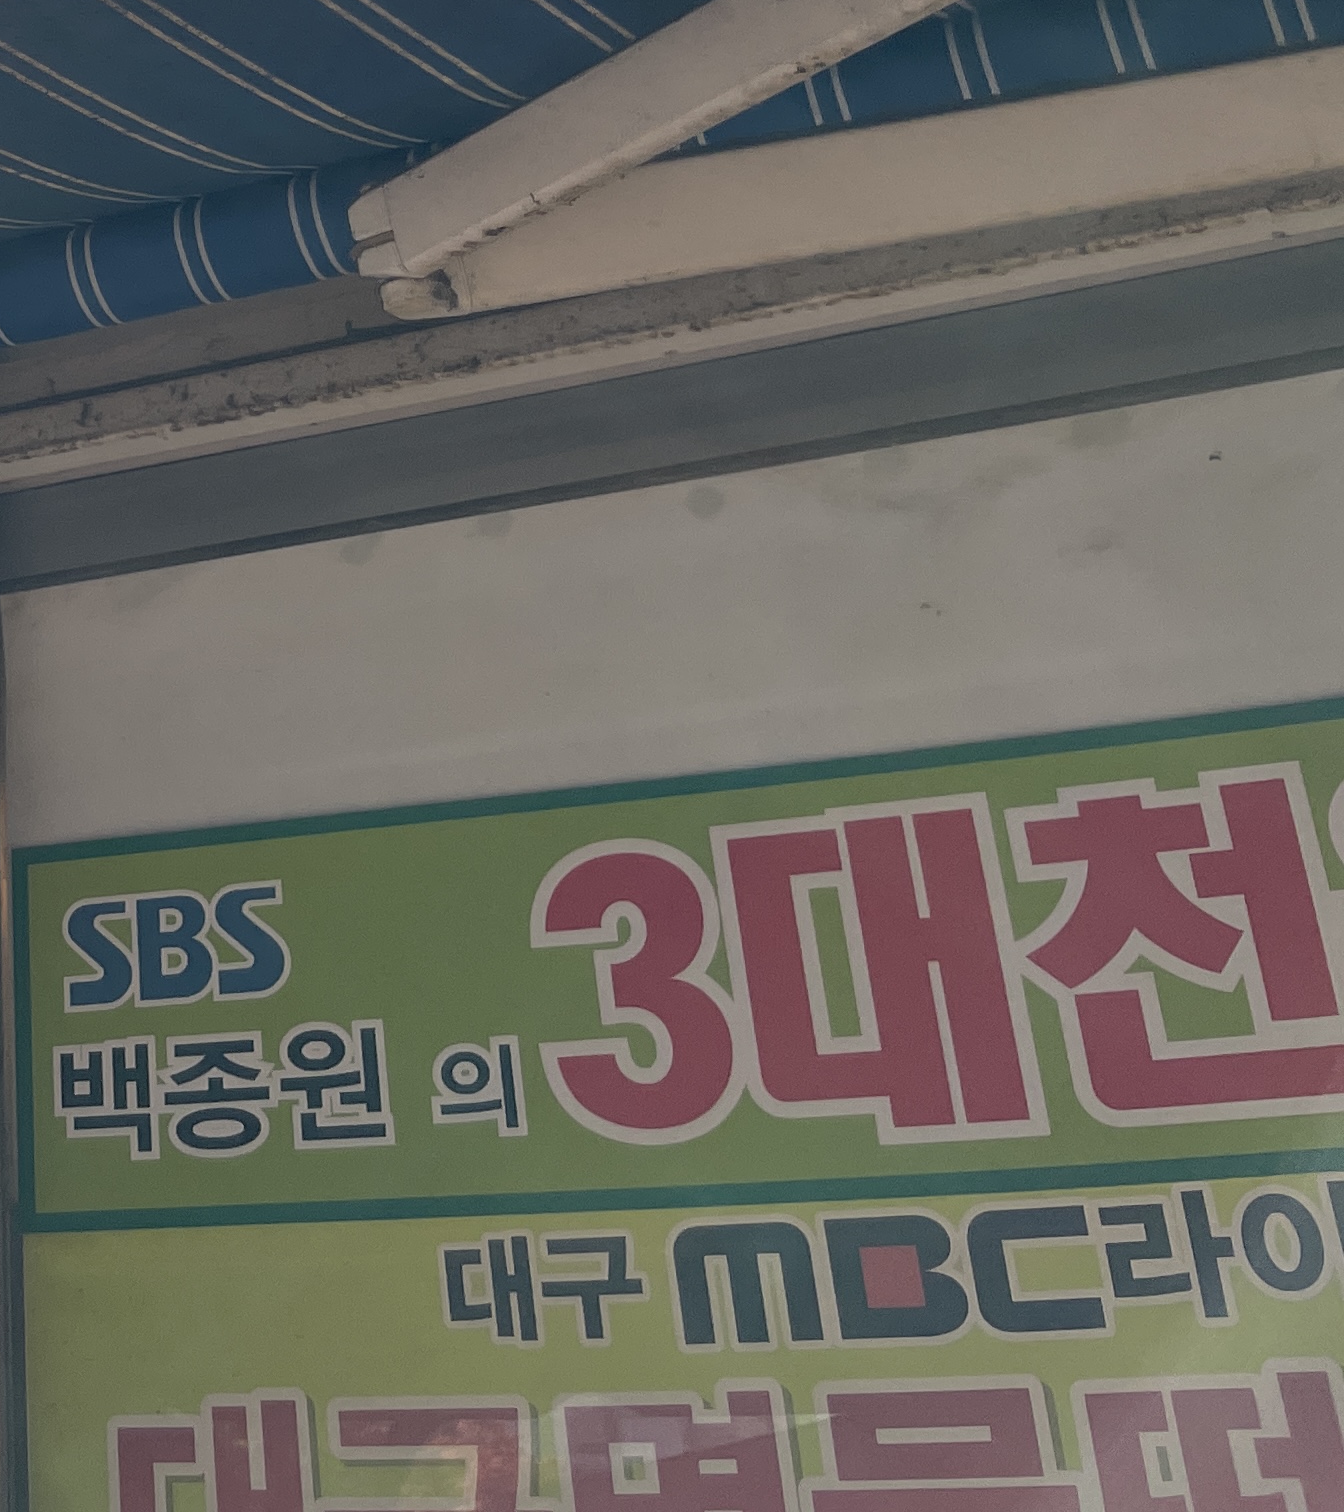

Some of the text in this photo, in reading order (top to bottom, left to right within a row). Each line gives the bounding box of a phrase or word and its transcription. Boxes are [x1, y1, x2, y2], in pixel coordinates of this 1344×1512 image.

[60, 879, 290, 1013] SBS
[531, 760, 1344, 1146] 3대천
[53, 1018, 527, 1159] 백종원 의
[440, 1230, 649, 1345] 대구
